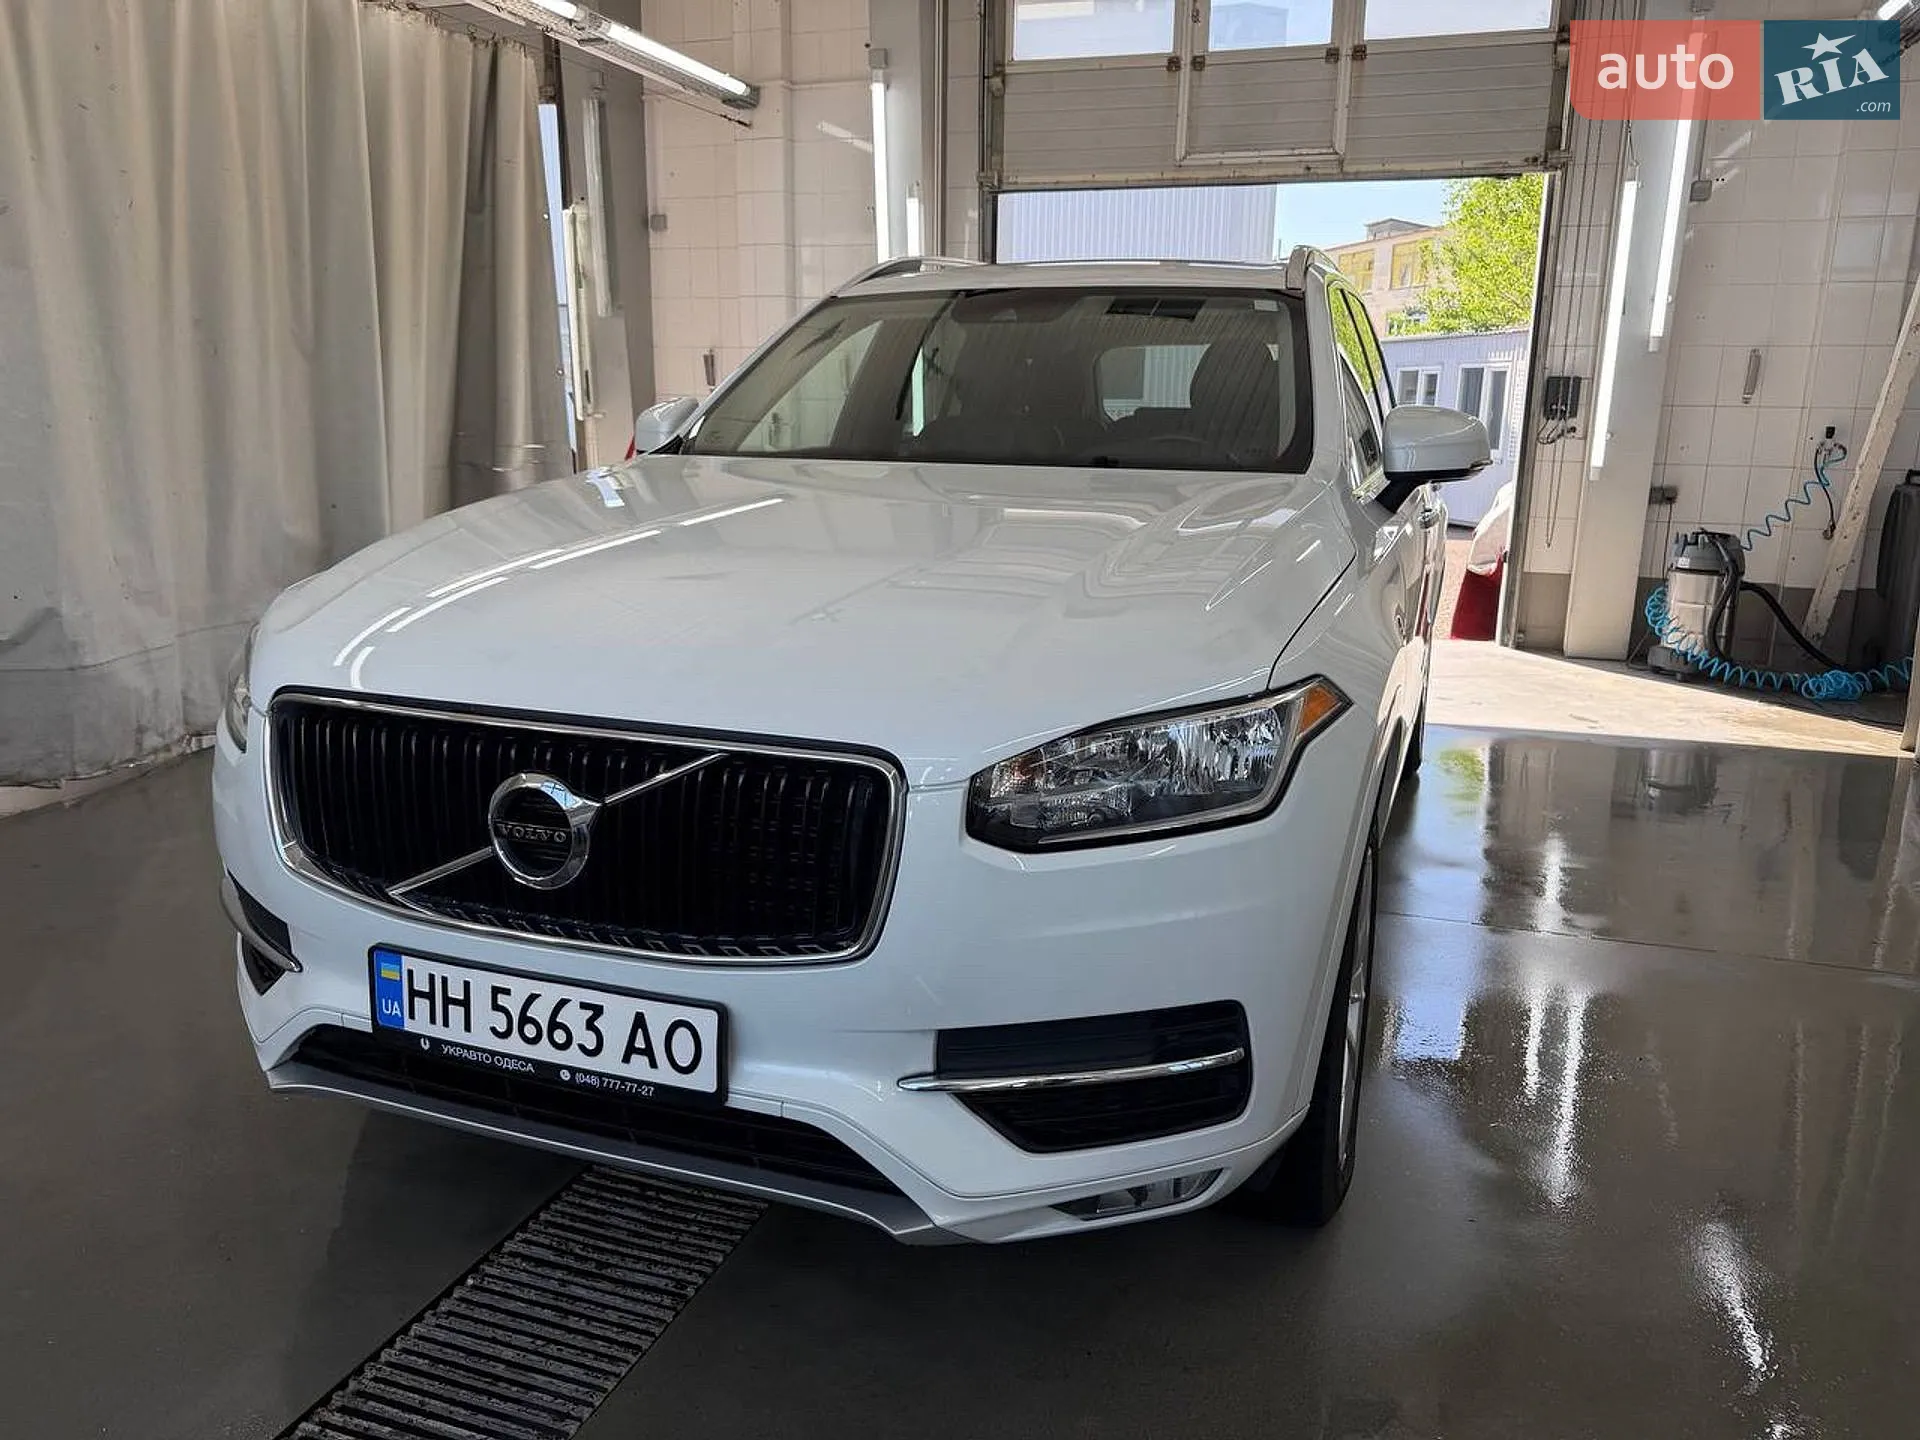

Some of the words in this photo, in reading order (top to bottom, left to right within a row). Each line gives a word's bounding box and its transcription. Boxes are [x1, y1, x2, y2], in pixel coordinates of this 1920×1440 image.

[496, 823, 567, 843] VOLVO
[381, 998, 402, 1018] UA
[406, 967, 472, 1034] HH
[488, 984, 605, 1058] 5663
[620, 1010, 703, 1075] AO
[441, 1043, 492, 1064] УКРАВТО
[493, 1055, 536, 1074] ОДЕСА
[574, 1072, 600, 1089] (048)
[601, 1077, 655, 1097] 777-77-27
